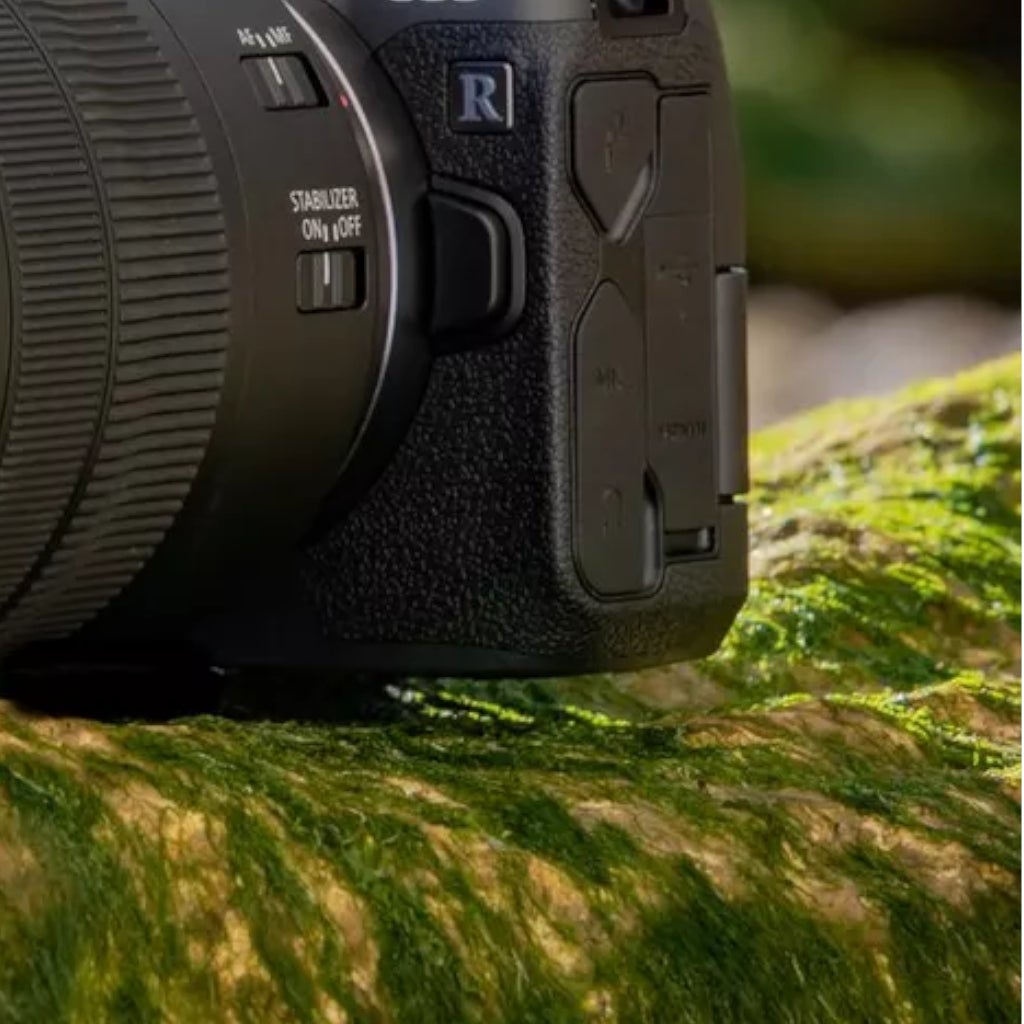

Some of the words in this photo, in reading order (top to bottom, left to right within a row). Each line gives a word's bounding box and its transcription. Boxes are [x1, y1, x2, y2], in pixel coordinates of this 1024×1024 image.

[460, 73, 502, 123] R
[289, 186, 359, 213] STABILIZER
[302, 218, 322, 240] ON
[337, 214, 362, 238] OFF
